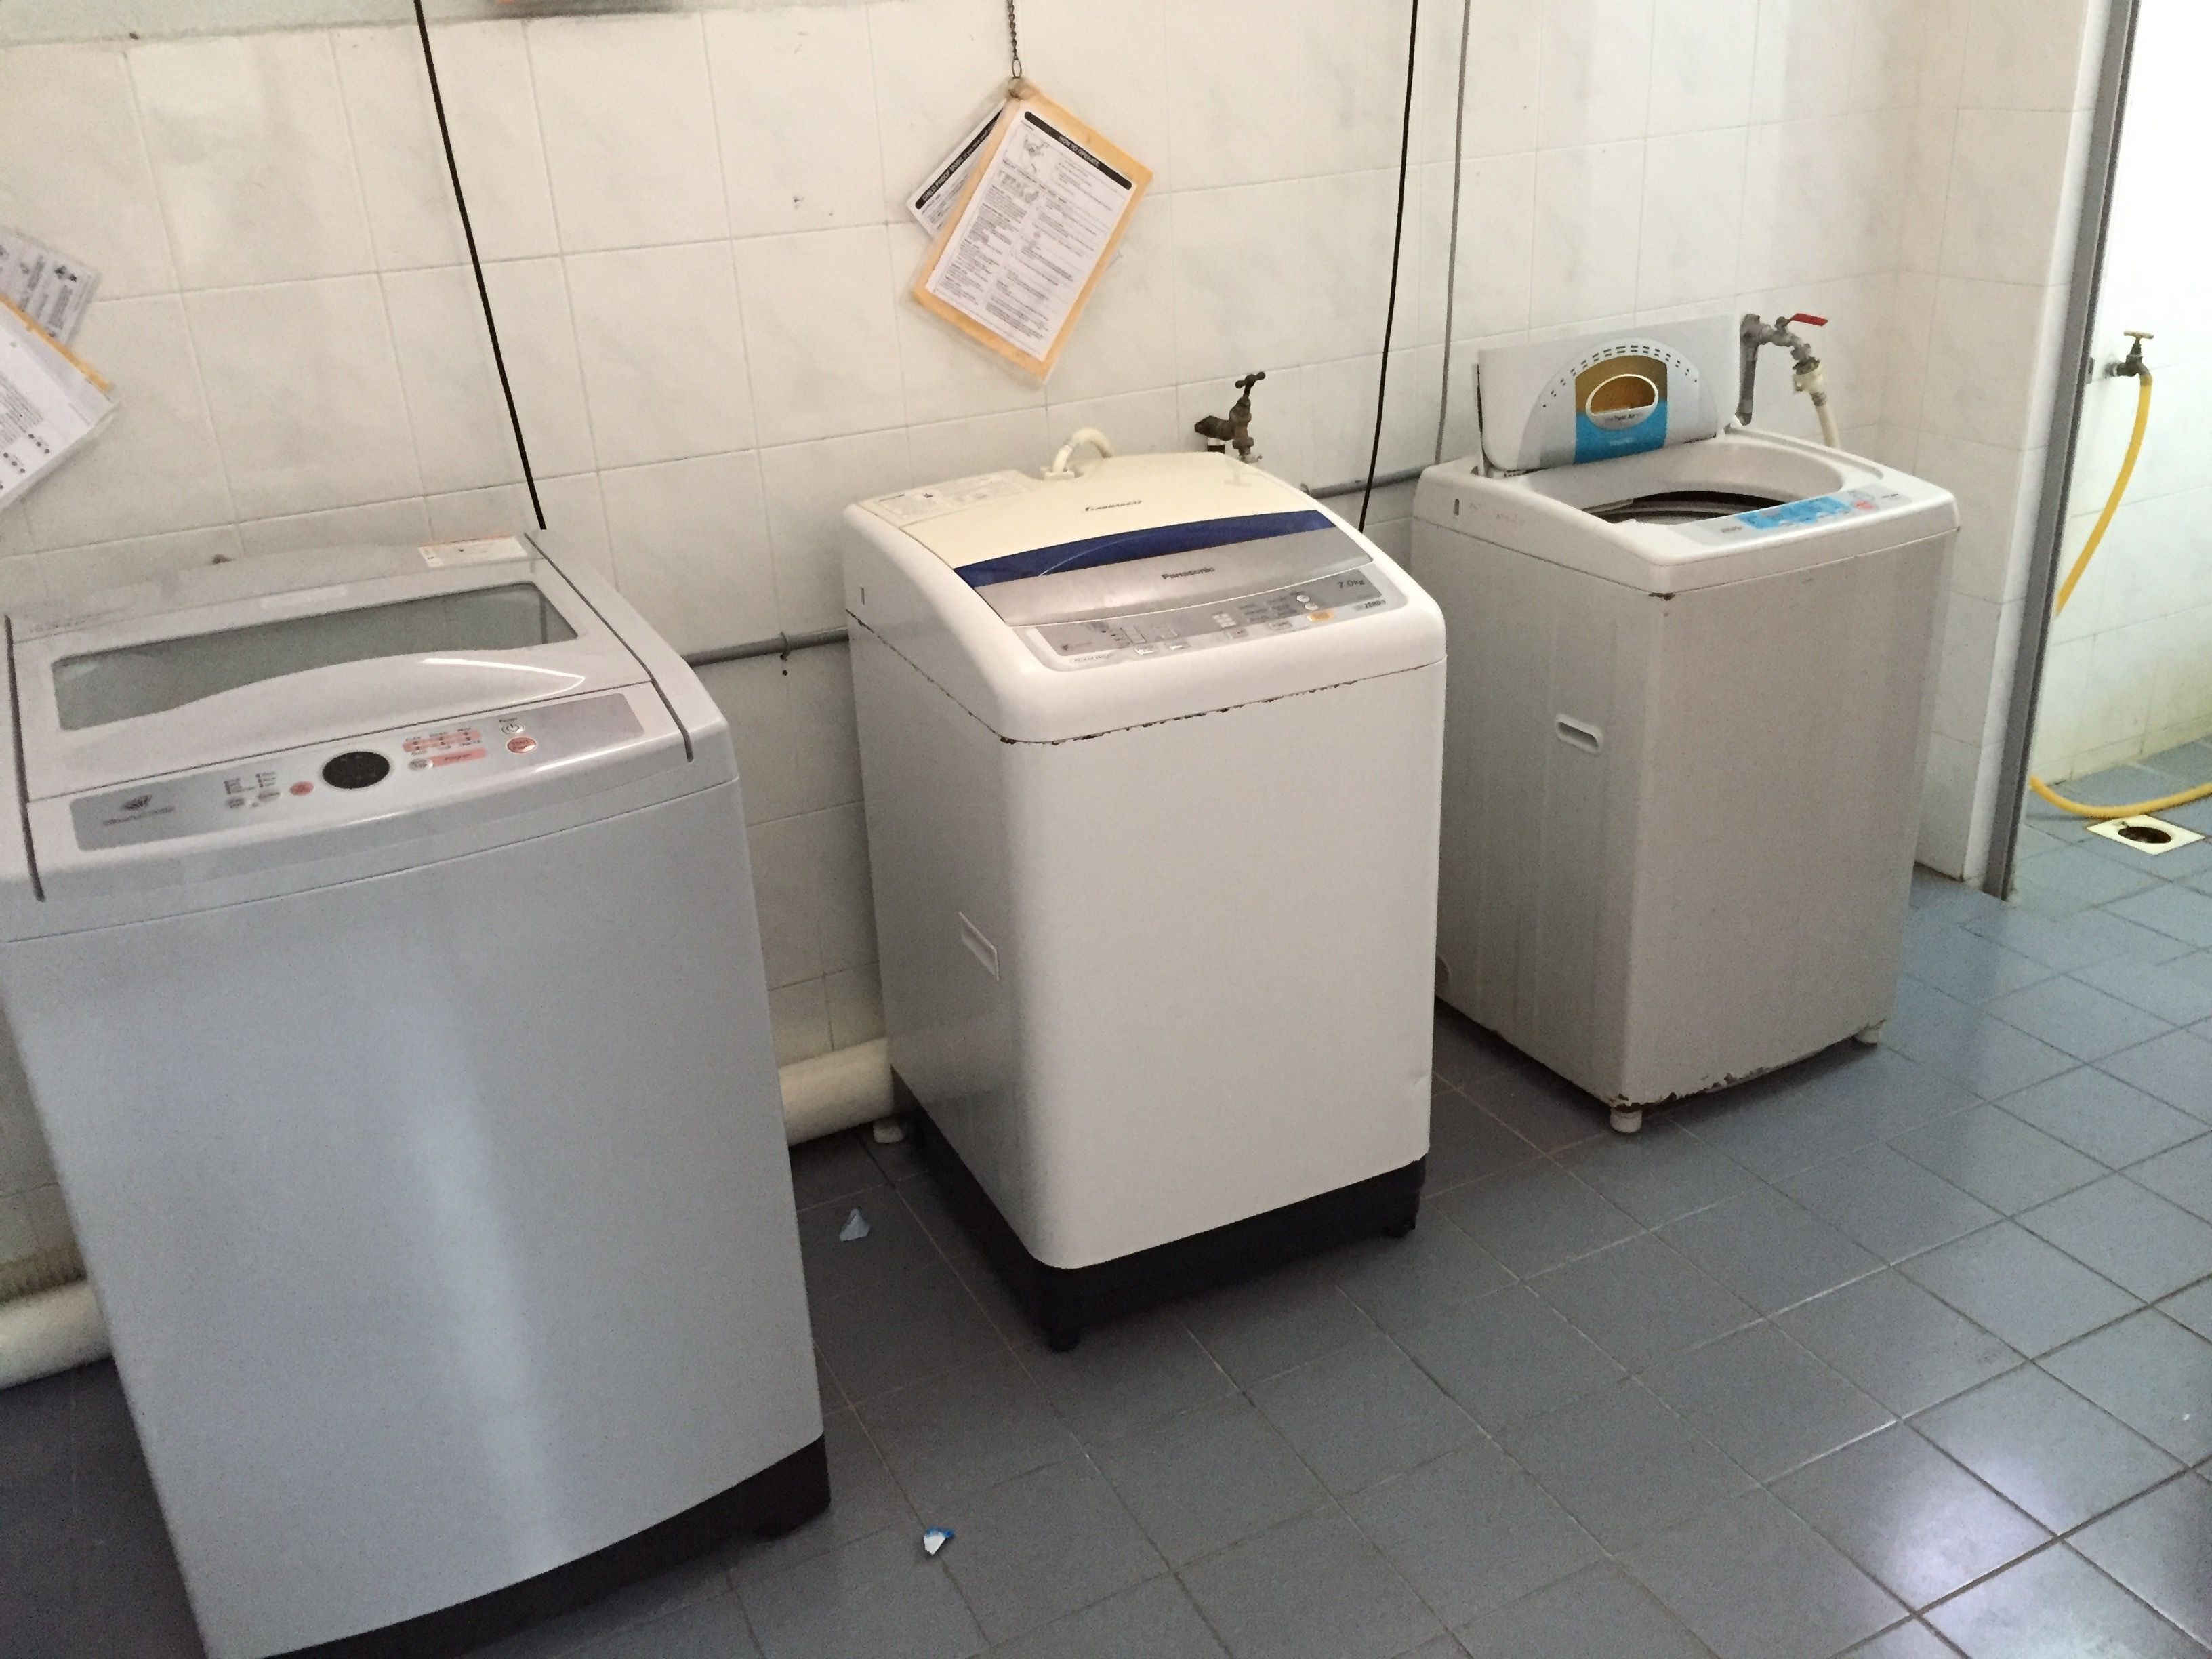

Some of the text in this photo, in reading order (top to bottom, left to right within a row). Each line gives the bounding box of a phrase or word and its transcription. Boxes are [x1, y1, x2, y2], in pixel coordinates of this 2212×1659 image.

[1058, 136, 1099, 167] HOW TO OPERATE
[922, 185, 937, 201] CHILD
[935, 169, 951, 188] PROOF
[949, 156, 964, 172] MODE
[1161, 567, 1215, 580] Panasonic
